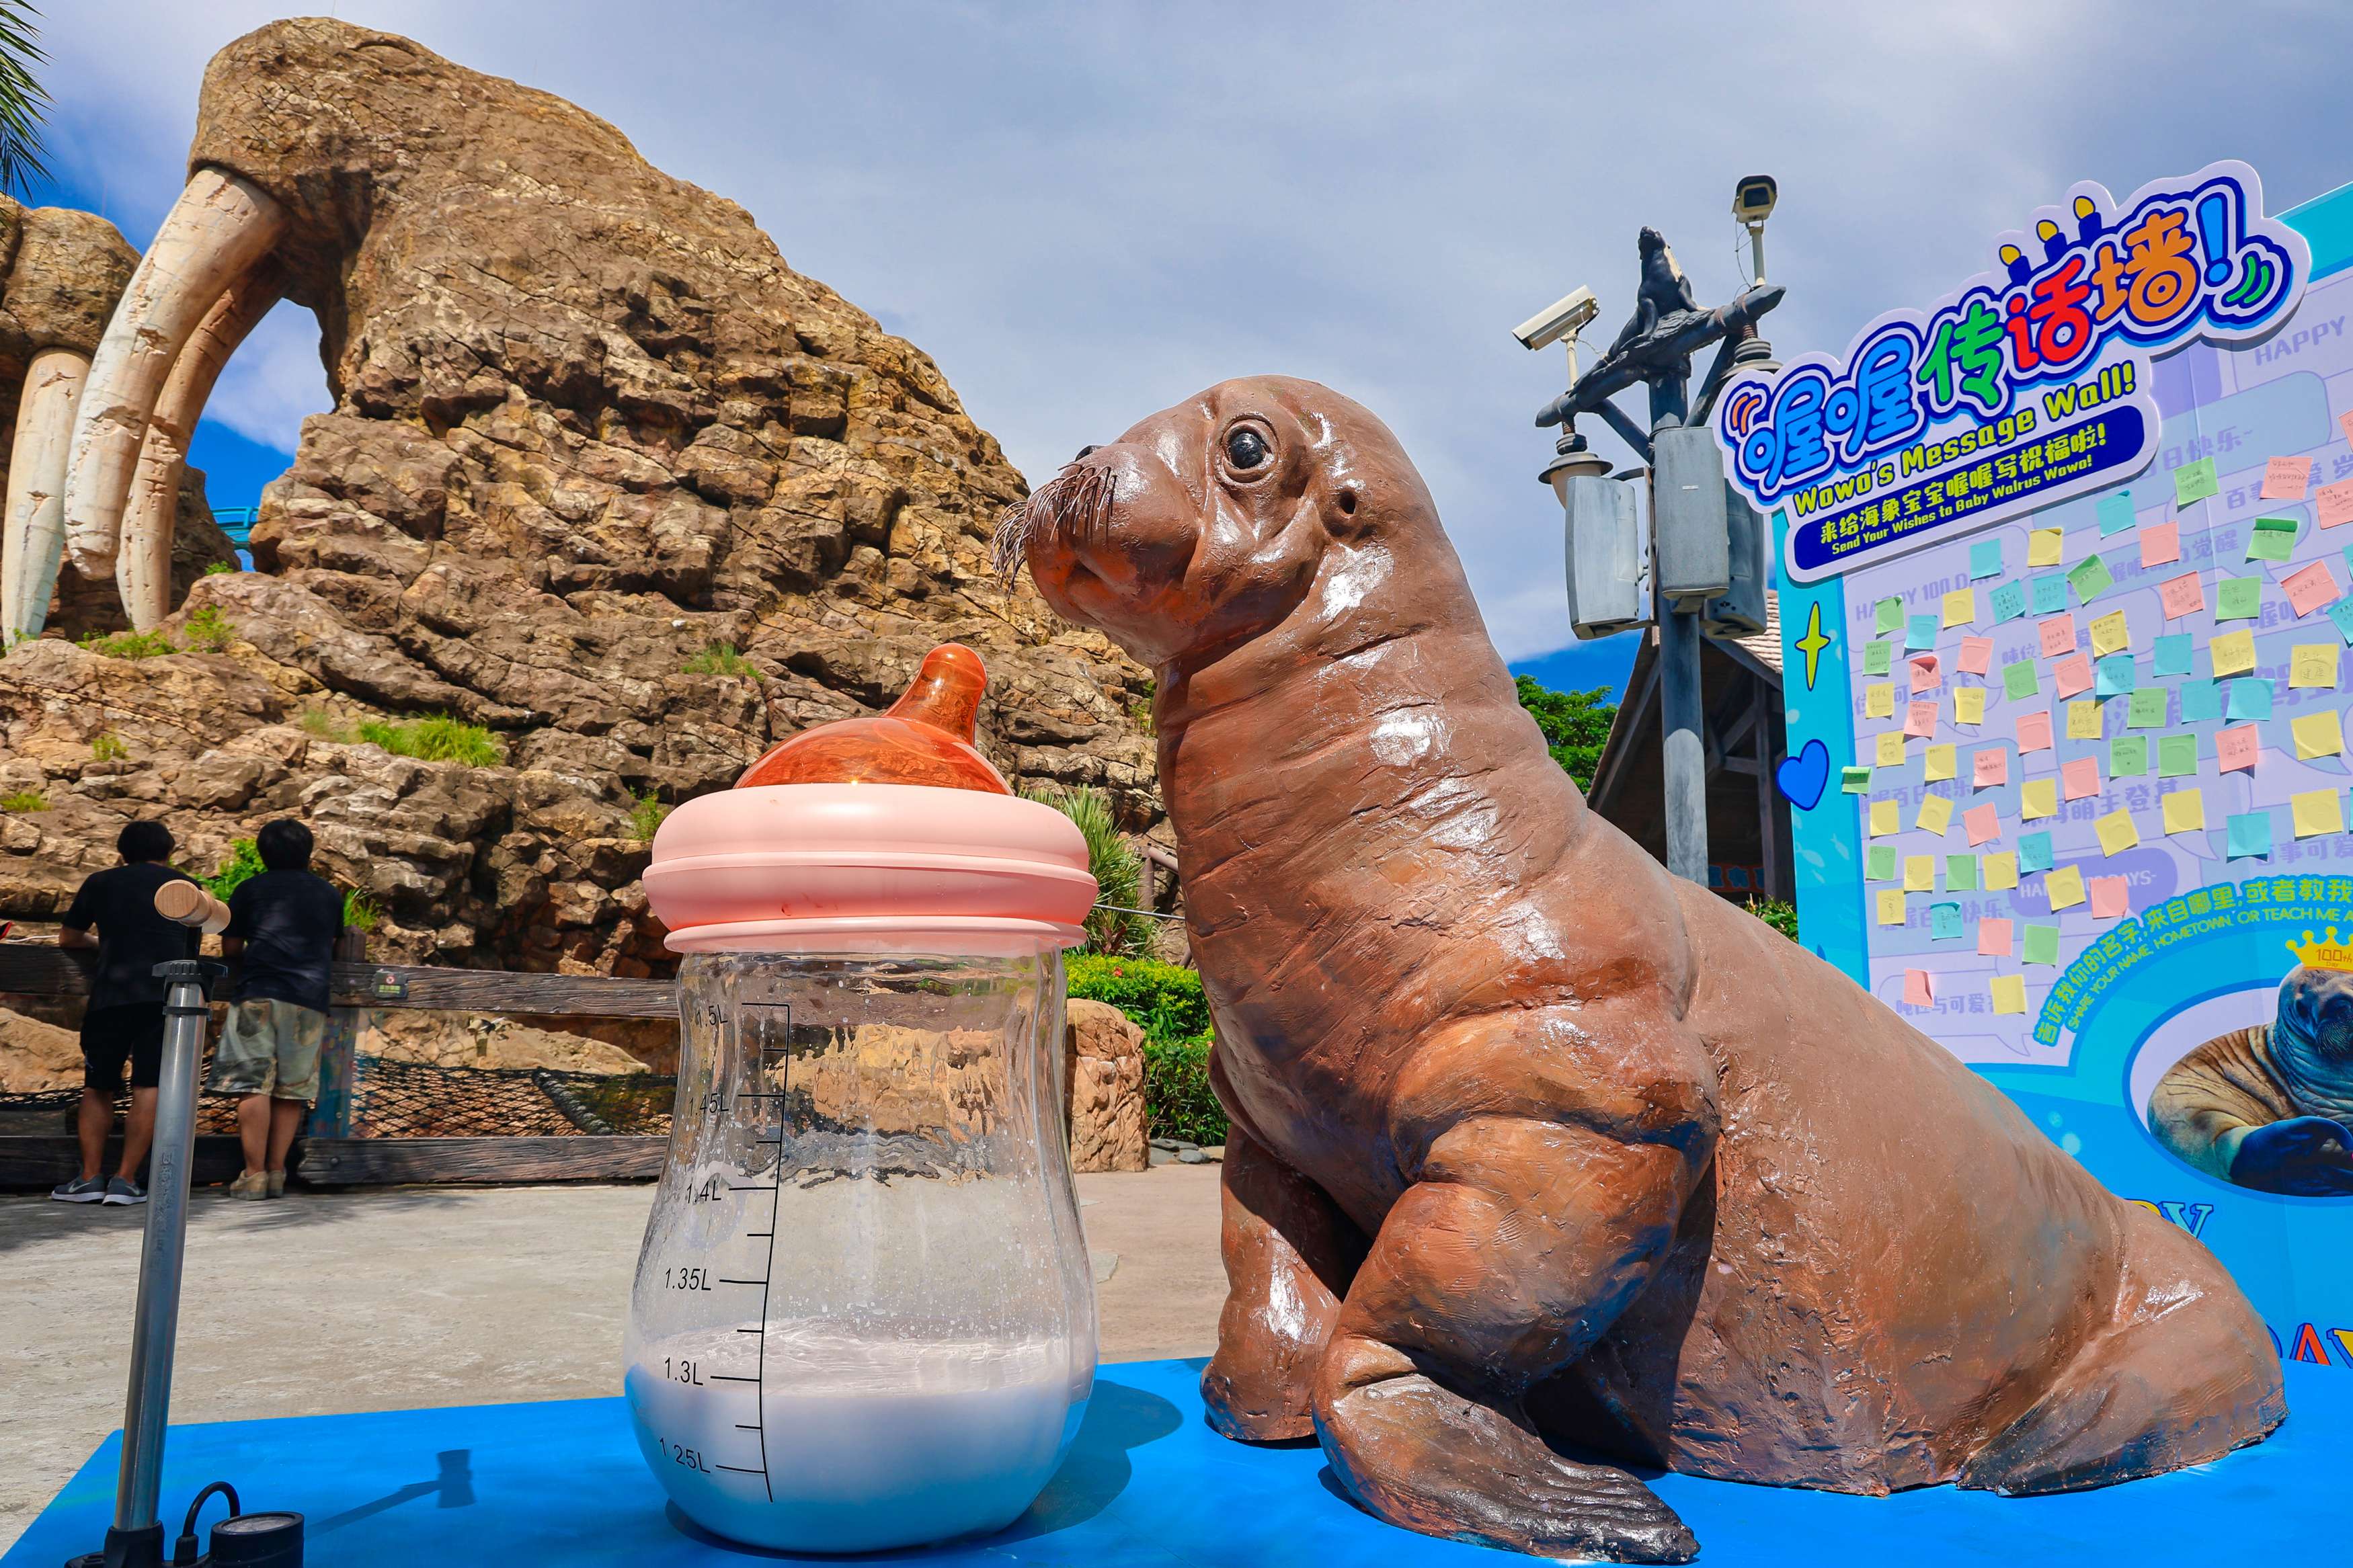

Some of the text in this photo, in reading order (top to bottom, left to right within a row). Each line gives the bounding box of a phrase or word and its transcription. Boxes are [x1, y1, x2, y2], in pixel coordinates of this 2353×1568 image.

[2255, 316, 2346, 366] HAPPY
[1794, 362, 2135, 515] Wowo's Message Wall!
[1832, 454, 2092, 554] Send Your Wishes to Baby Walrus Wowo!
[2069, 993, 2095, 1029] SHARE
[2090, 966, 2120, 994] YOUR
[2237, 910, 2260, 924] OR
[2262, 907, 2313, 921] TEACH
[2315, 908, 2341, 921] ME
[696, 1004, 728, 1028] 1.5L
[689, 1092, 729, 1117] 1.45L
[686, 1180, 721, 1204] 1.4L
[665, 1267, 711, 1291] 1.35L
[664, 1356, 704, 1386] 1.3L
